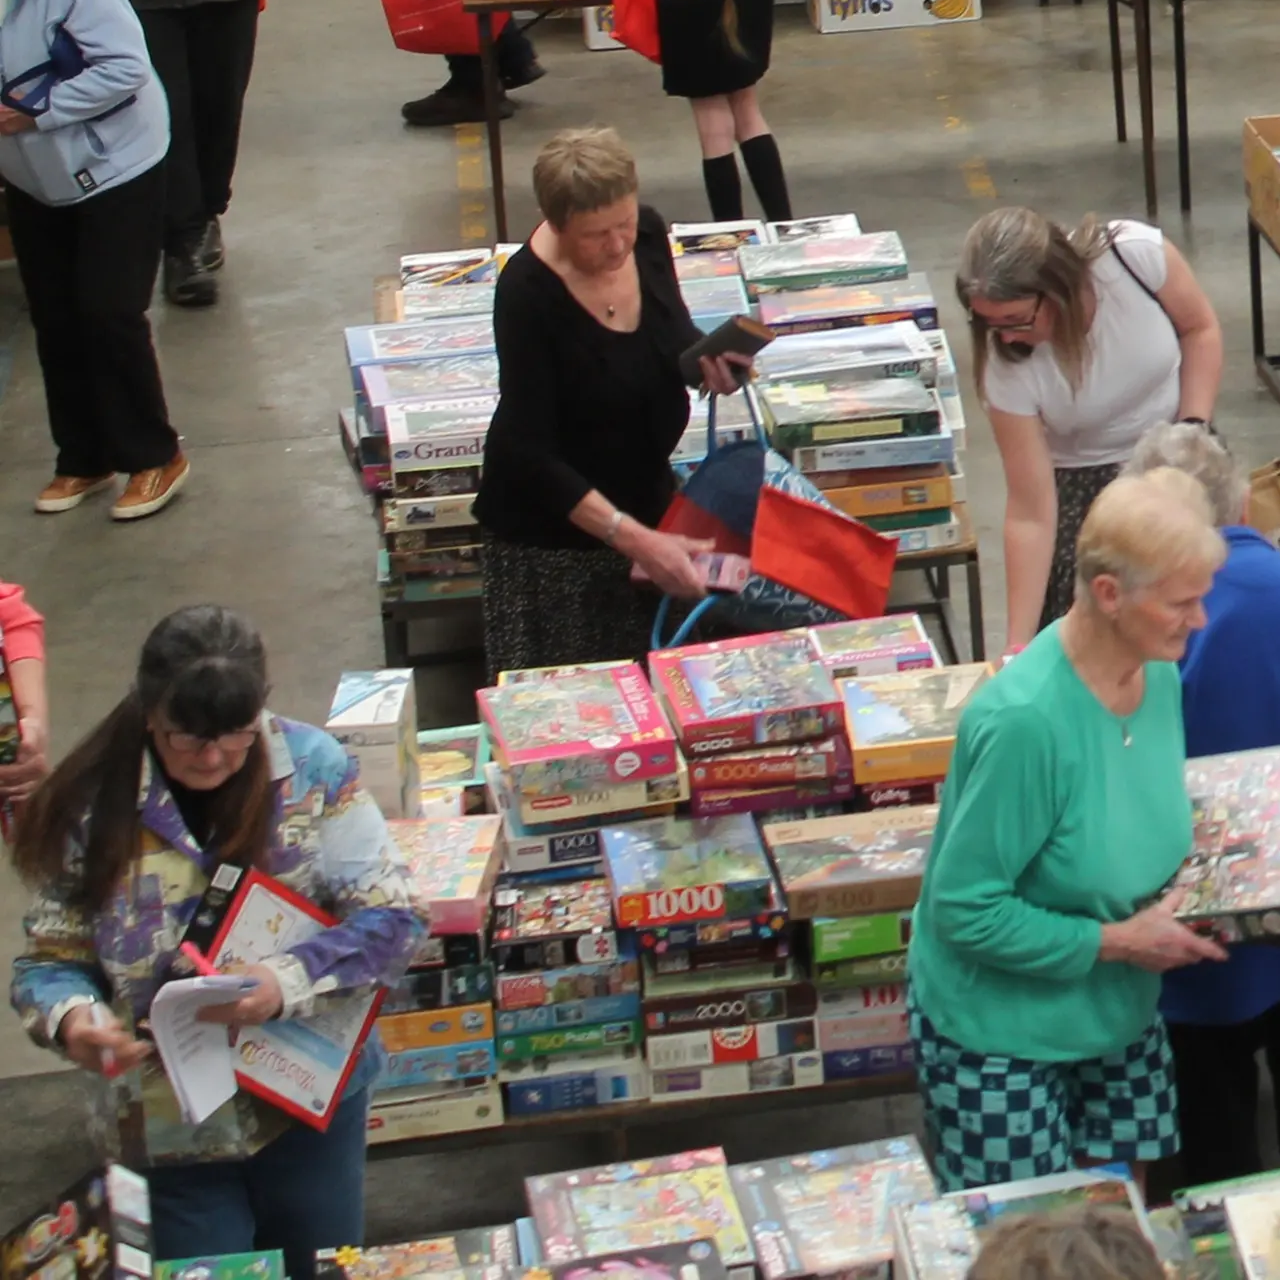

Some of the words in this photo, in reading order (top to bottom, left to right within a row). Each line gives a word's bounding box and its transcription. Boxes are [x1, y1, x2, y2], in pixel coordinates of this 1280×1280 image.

[690, 737, 733, 753] 1000
[714, 765, 757, 780] 1000
[759, 760, 794, 773] Puzzle
[573, 790, 610, 805] 1000
[870, 789, 911, 804] Gallery
[554, 833, 596, 852] 1000
[646, 887, 724, 920] 1000
[826, 890, 873, 907] 500
[695, 999, 745, 1019] 2000
